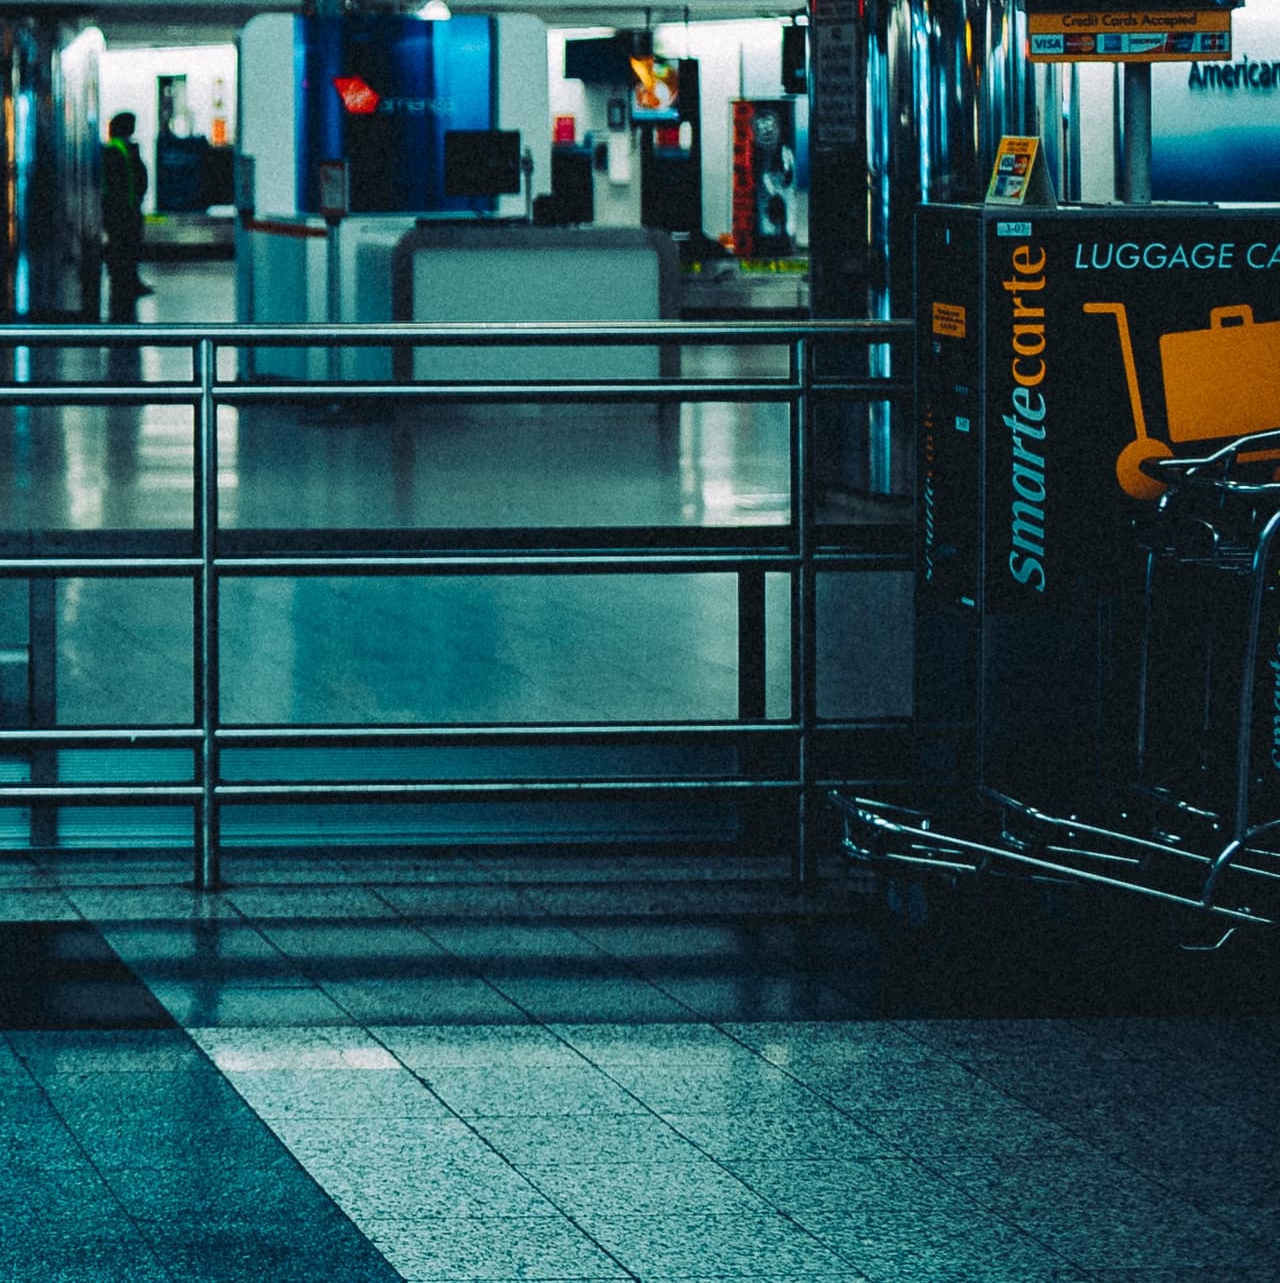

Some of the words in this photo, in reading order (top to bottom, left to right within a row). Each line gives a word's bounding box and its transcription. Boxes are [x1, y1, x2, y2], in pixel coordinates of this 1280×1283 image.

[1062, 15, 1098, 27] Credit
[1102, 14, 1138, 27] Cards
[1142, 13, 1198, 27] Accepted
[1034, 38, 1062, 49] VISA
[1075, 243, 1235, 269] LUGGAGE
[1002, 245, 1046, 592] smartecarte
